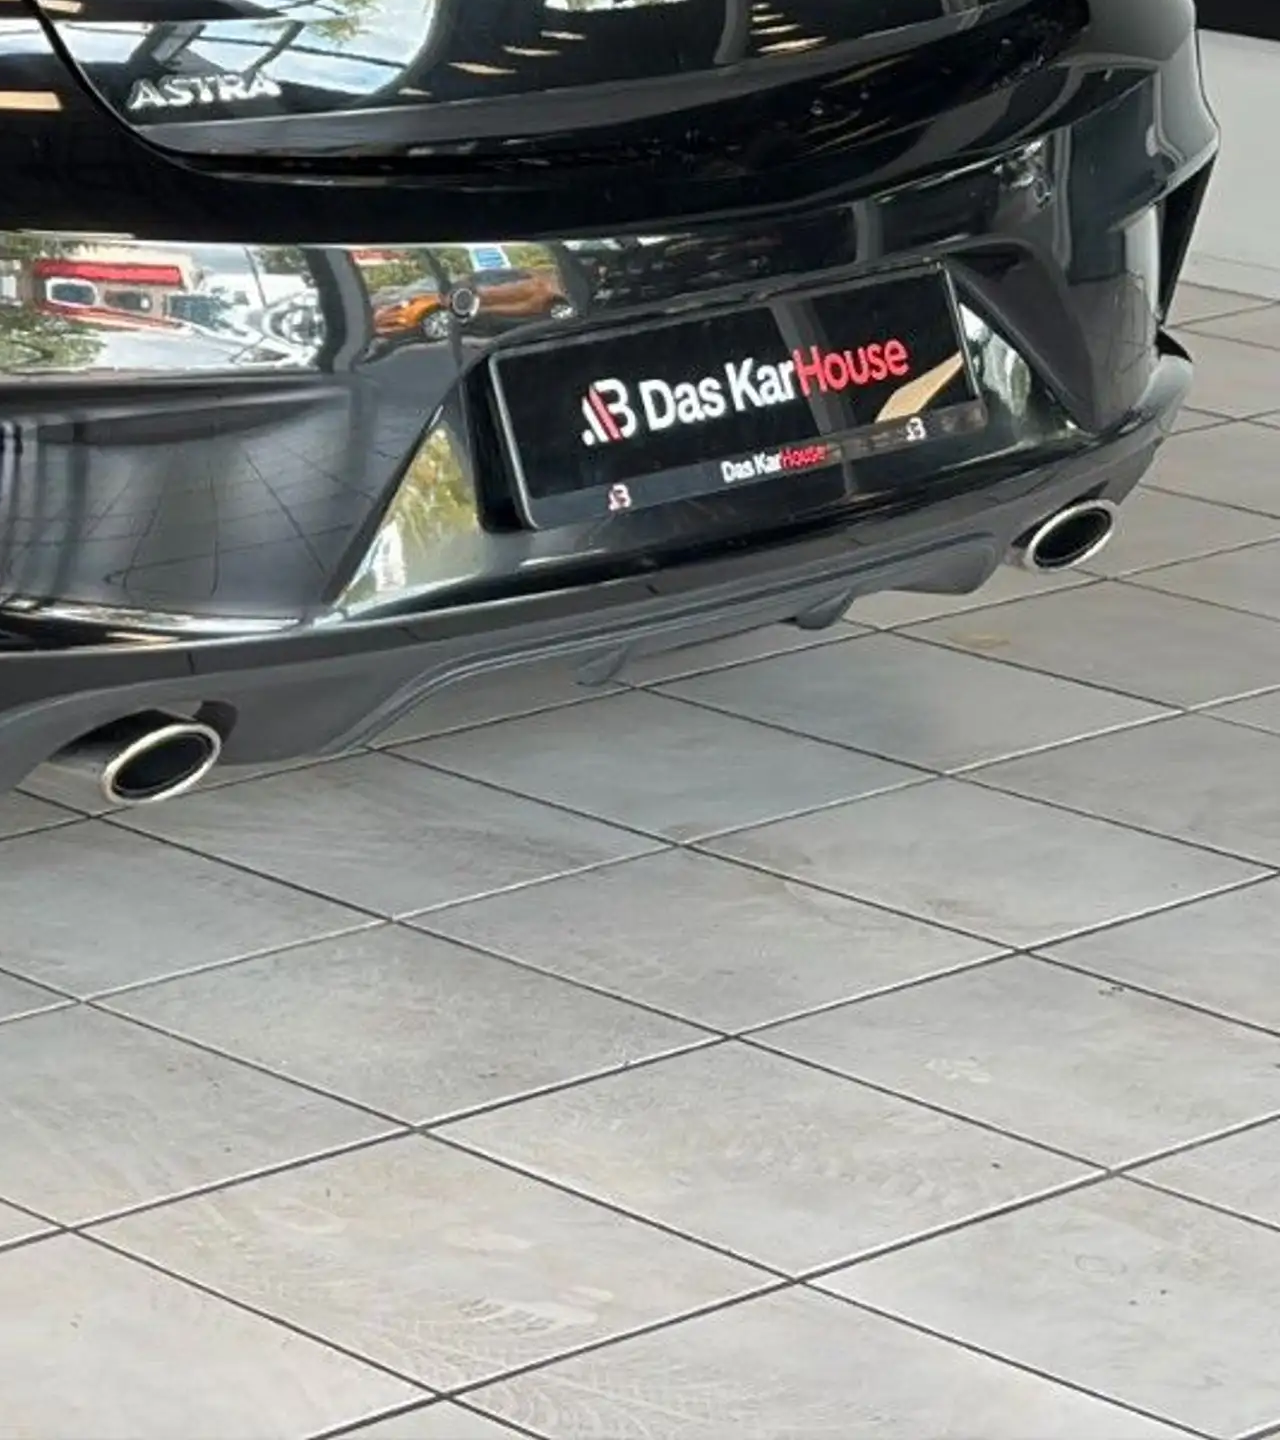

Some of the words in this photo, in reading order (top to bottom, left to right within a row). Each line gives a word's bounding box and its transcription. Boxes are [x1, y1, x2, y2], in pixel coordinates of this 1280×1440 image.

[128, 72, 282, 109] ASTRA
[640, 376, 726, 432] Das
[721, 458, 754, 483] Das
